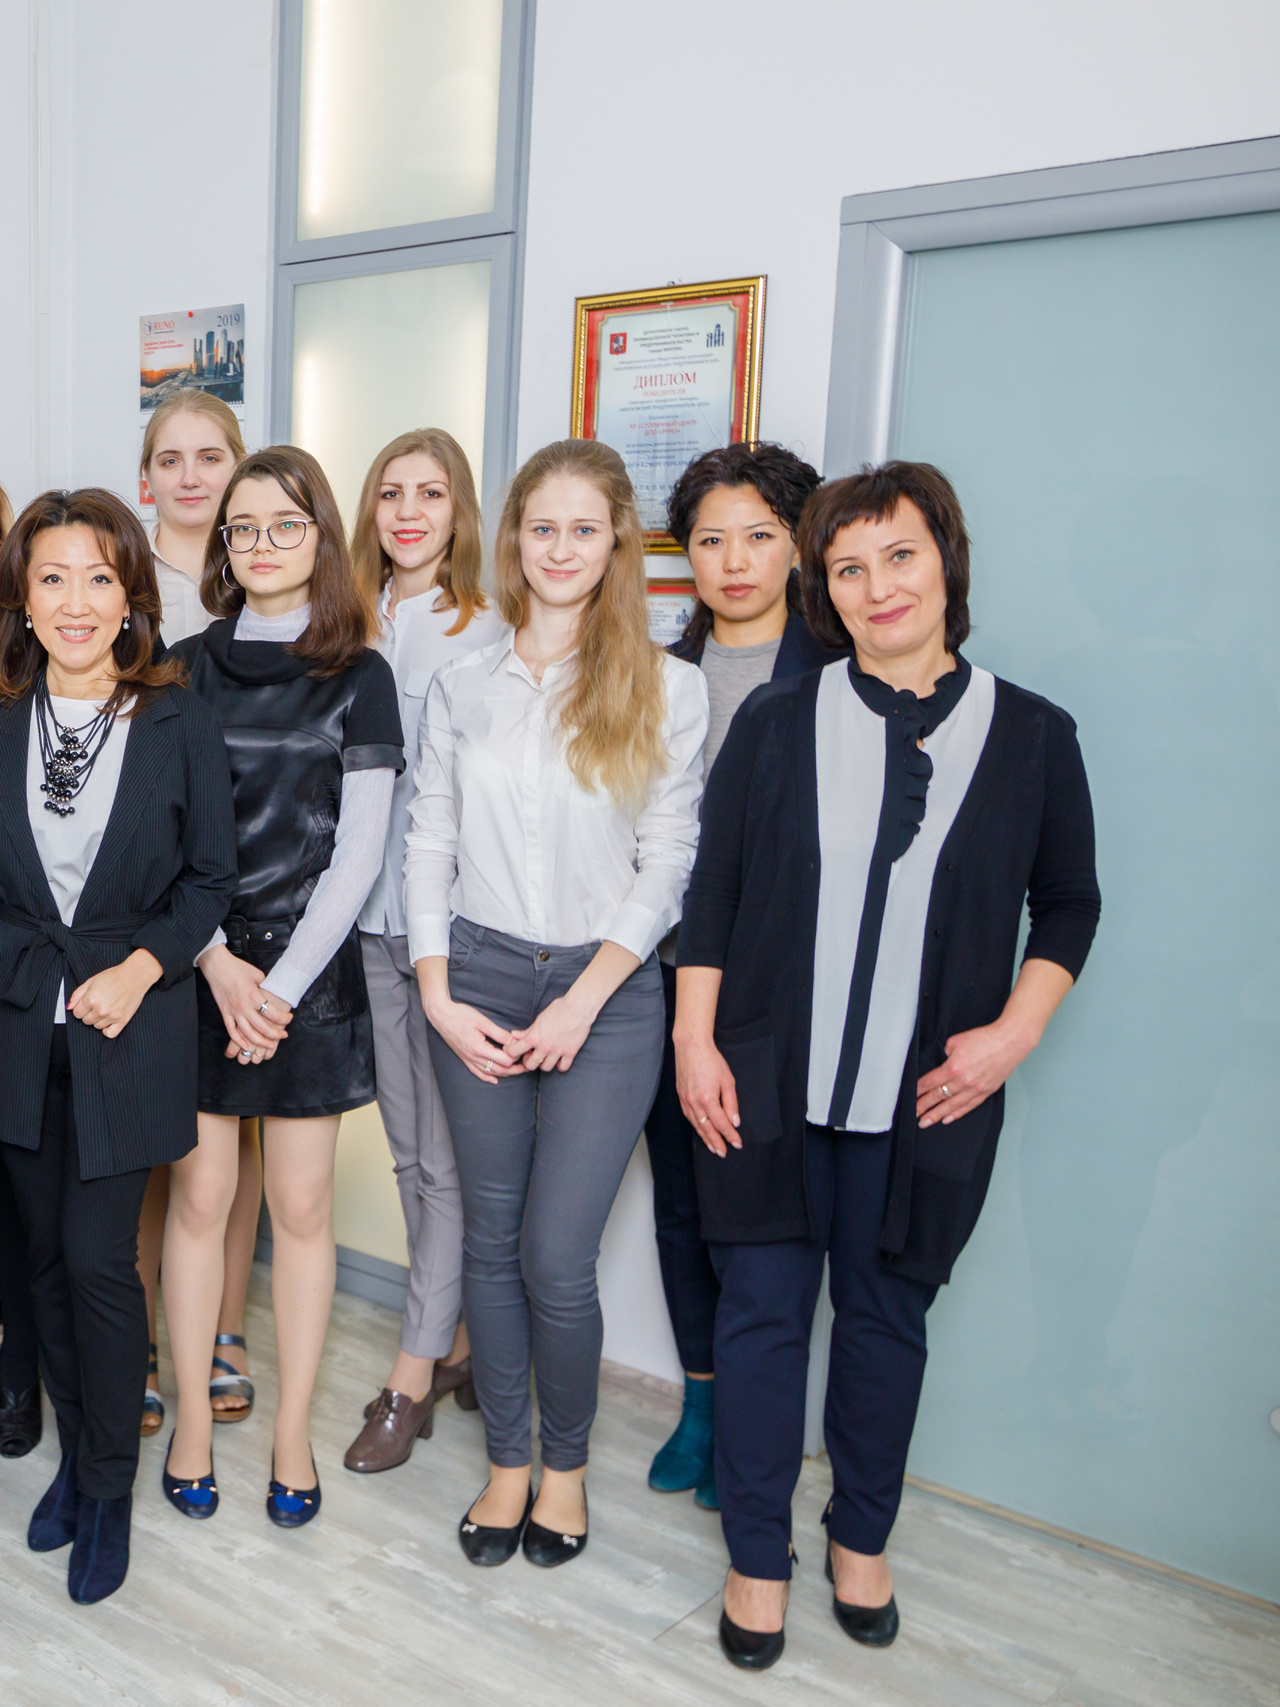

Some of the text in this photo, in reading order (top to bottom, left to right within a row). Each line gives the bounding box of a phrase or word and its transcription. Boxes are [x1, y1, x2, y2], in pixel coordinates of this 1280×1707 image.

[153, 320, 176, 331] RUNO
[216, 313, 241, 328] 2019
[633, 371, 697, 390] ДИПЛОМ
